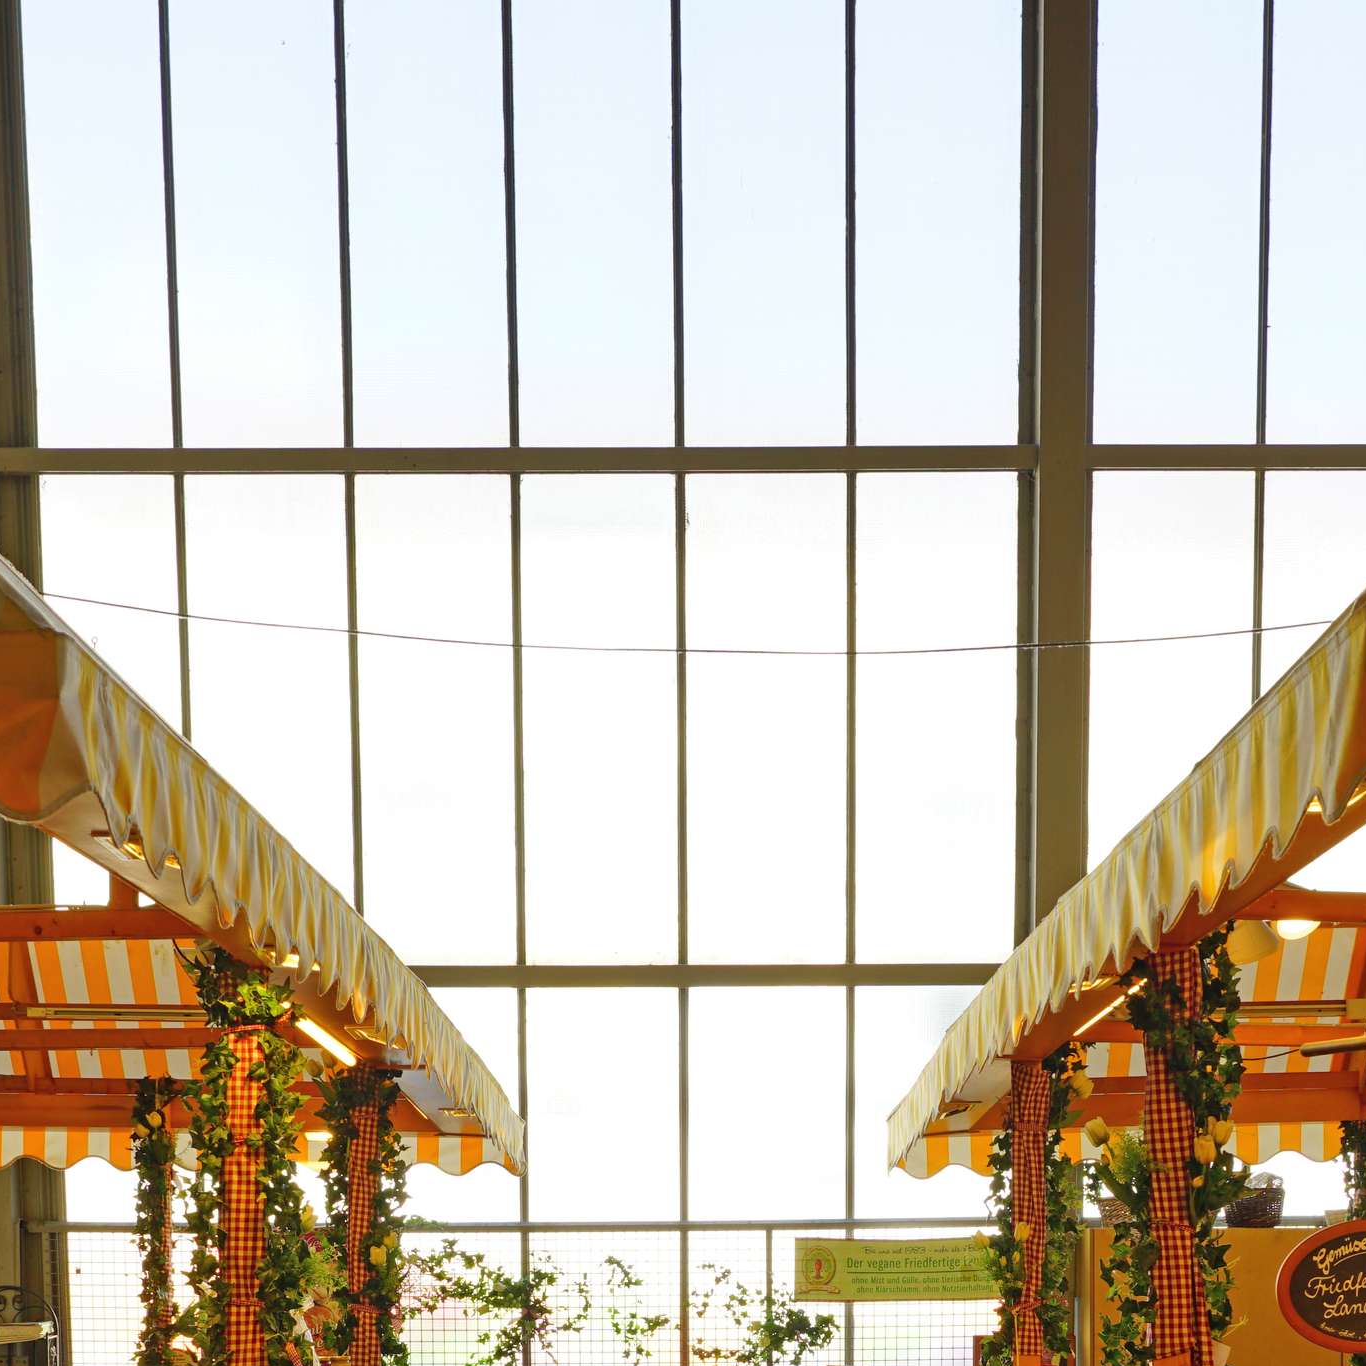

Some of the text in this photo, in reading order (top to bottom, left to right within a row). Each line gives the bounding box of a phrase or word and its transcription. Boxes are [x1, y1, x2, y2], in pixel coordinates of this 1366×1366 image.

[847, 1257, 960, 1272] Der vegane Friedfertige
